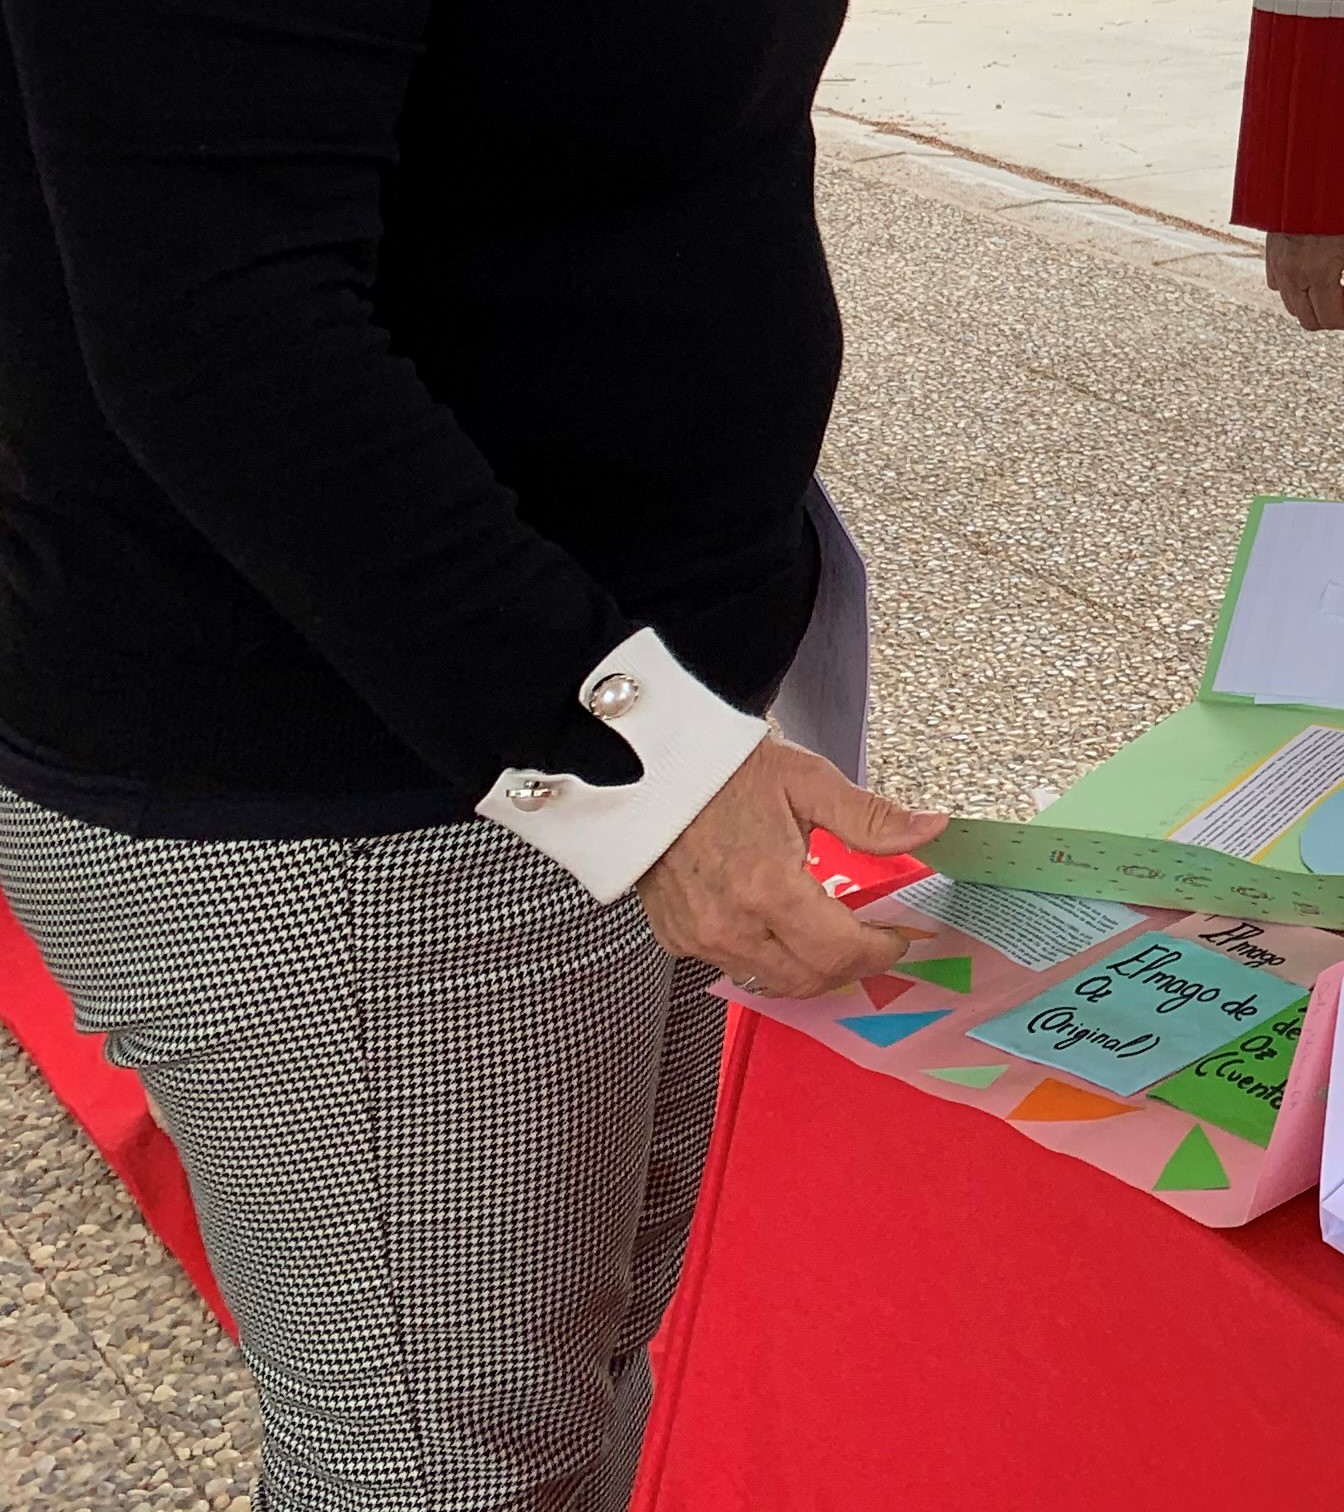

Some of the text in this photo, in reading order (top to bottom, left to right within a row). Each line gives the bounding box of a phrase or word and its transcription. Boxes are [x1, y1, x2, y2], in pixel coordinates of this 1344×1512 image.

[1074, 973, 1113, 1005] Oz
[1139, 963, 1221, 1015] mago
[1220, 995, 1260, 1022] de
[1027, 1005, 1160, 1060] (Original)
[1240, 1033, 1279, 1062] Oz
